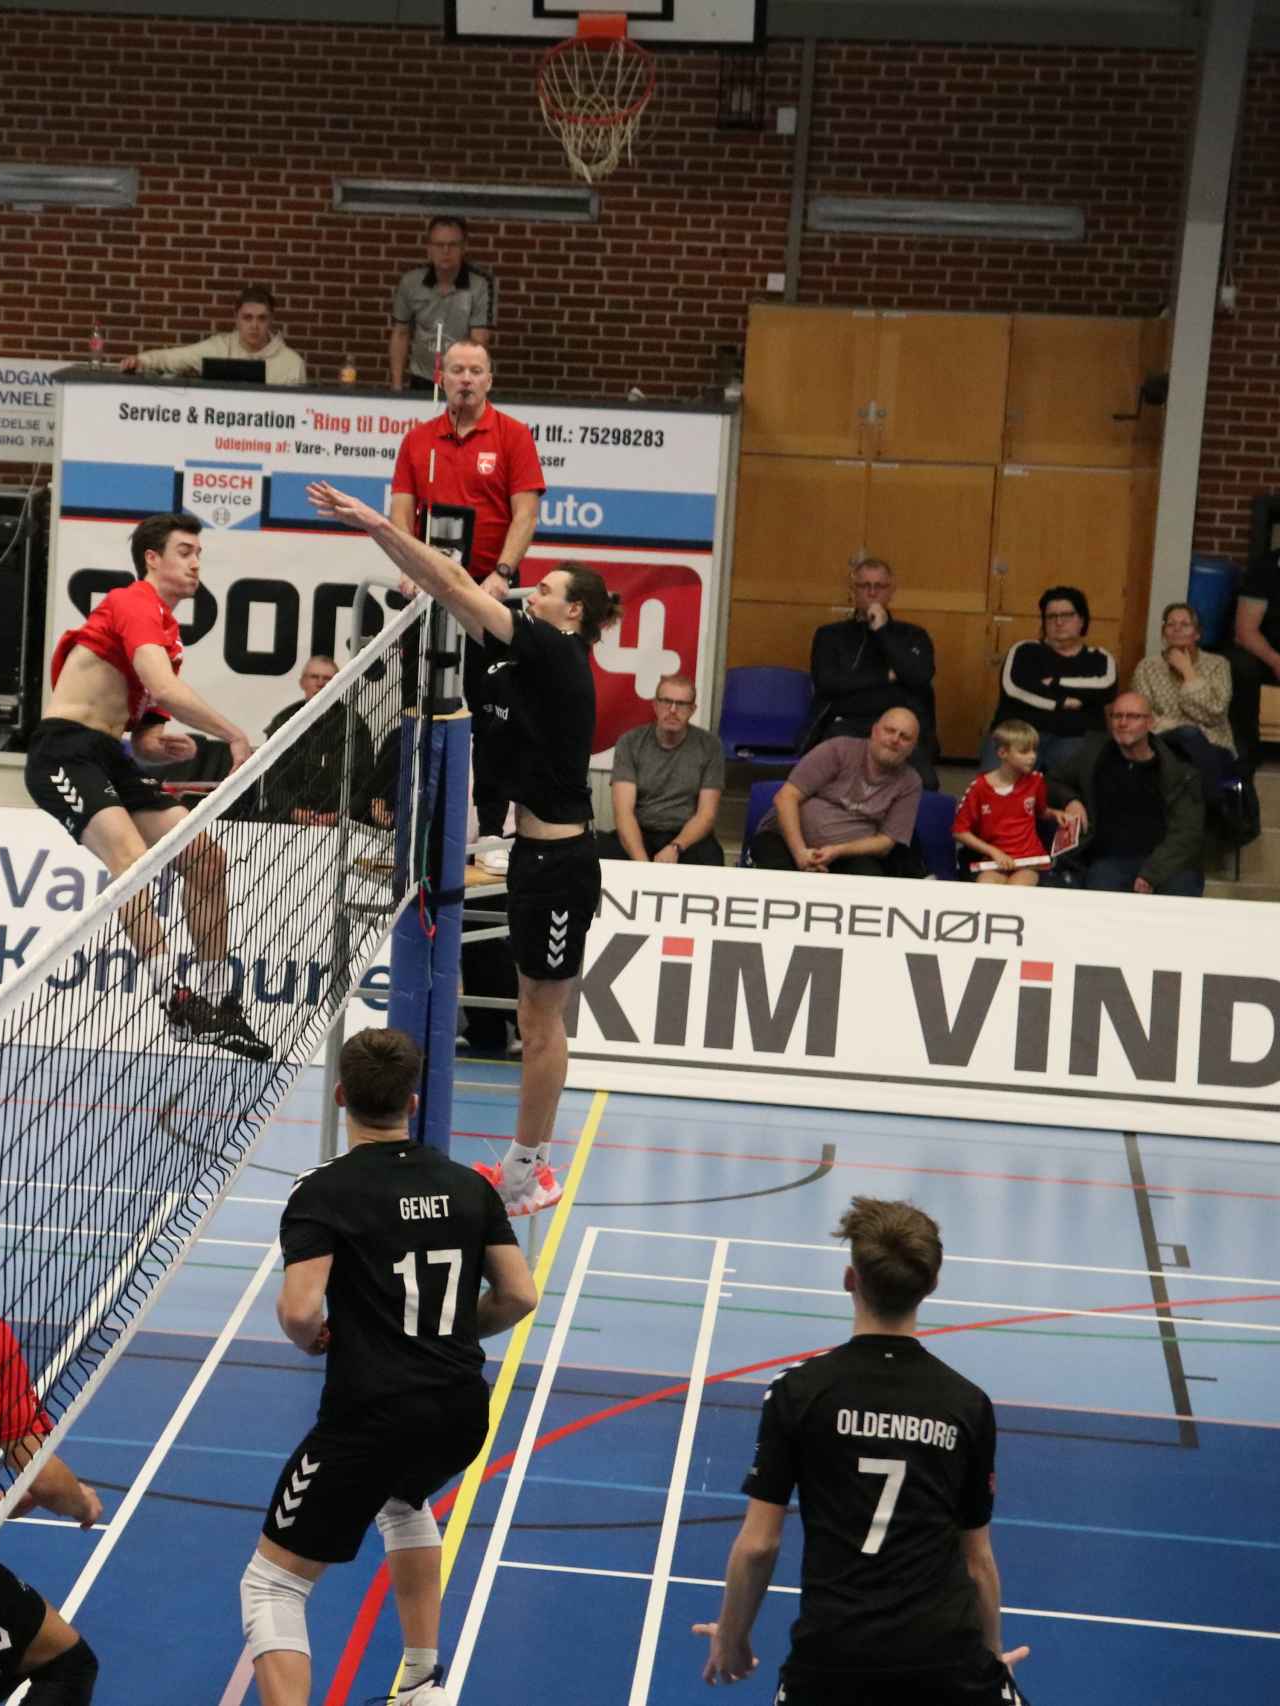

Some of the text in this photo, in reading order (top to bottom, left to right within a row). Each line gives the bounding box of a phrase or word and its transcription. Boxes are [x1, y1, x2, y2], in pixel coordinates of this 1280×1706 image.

[119, 403, 181, 424] Service
[187, 407, 199, 424] &
[204, 408, 296, 430] Reparation
[356, 415, 372, 433] til
[579, 426, 665, 448] 75298283
[215, 436, 272, 455] Udlejning
[275, 439, 291, 454] af:
[540, 454, 565, 469] sser
[192, 473, 253, 490] BOSCH
[192, 490, 253, 507] Service
[535, 494, 603, 529] uto
[593, 886, 1025, 947] NTREPRENØR
[399, 1194, 450, 1220] GENET
[392, 1248, 463, 1337] 17
[836, 1408, 959, 1451] OLDENBORG
[857, 1456, 907, 1555] 7
